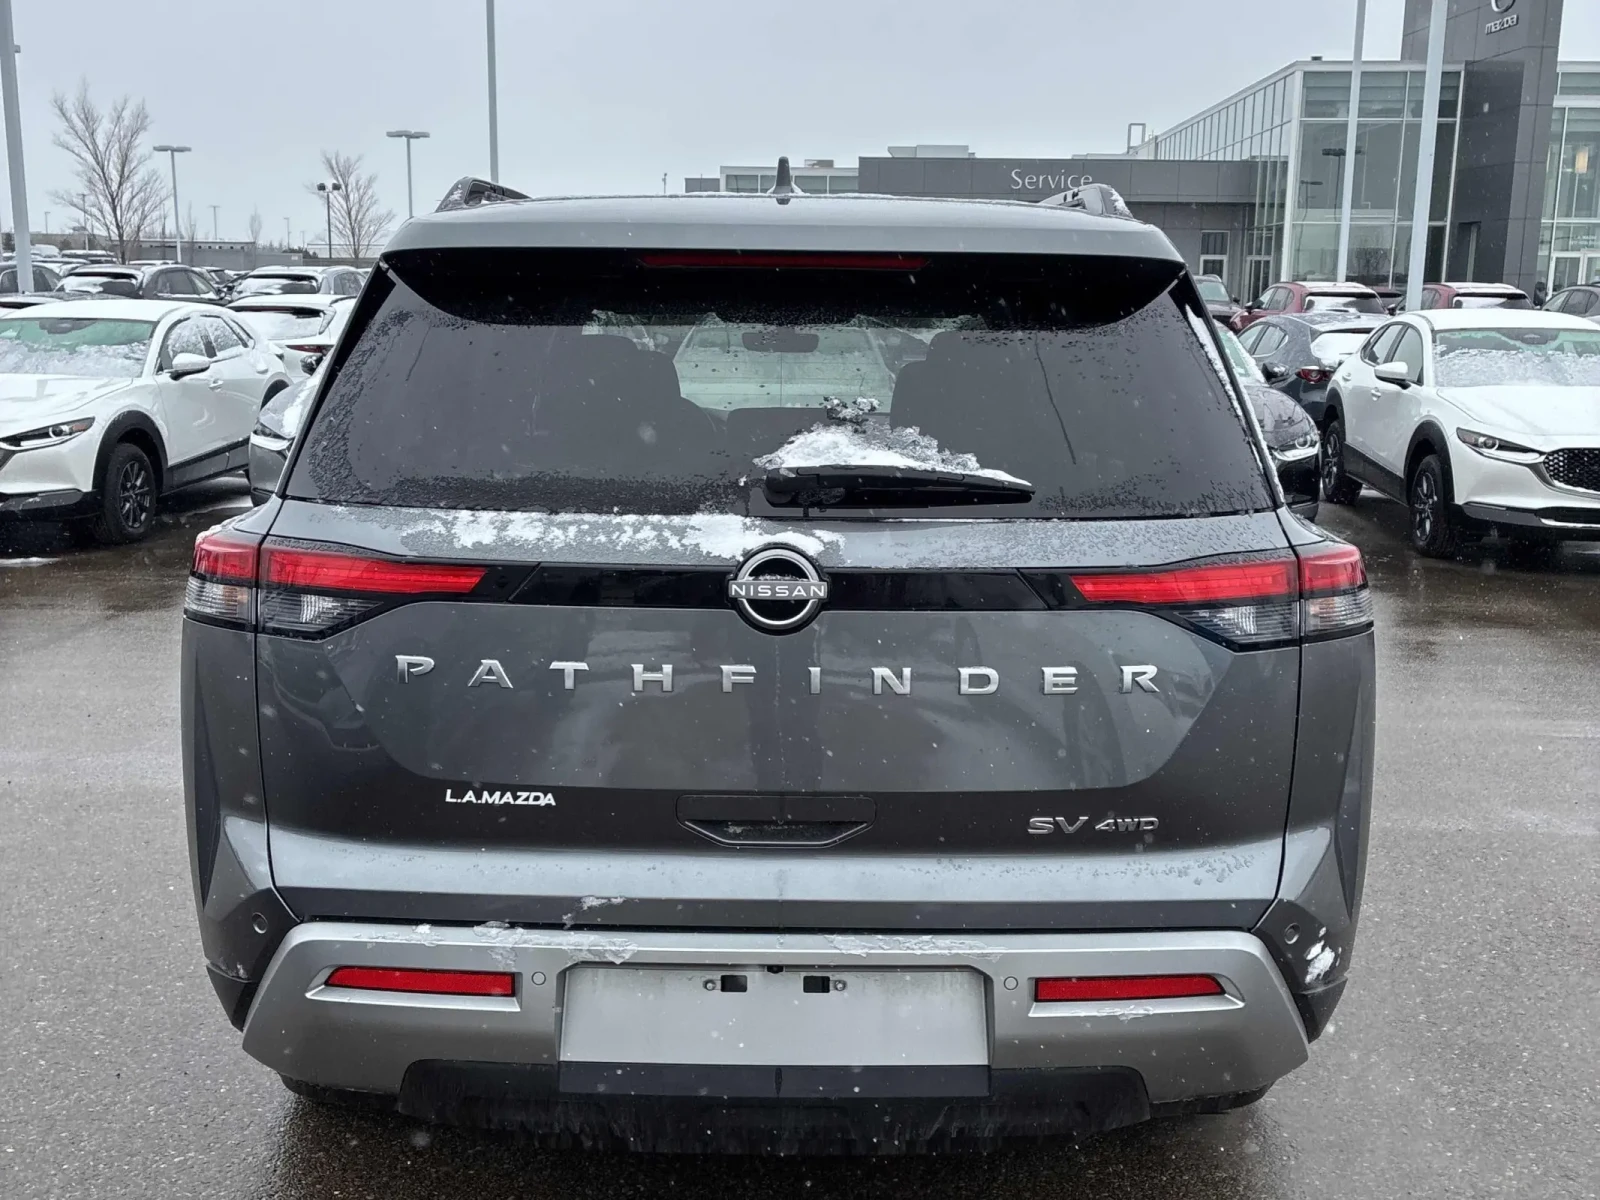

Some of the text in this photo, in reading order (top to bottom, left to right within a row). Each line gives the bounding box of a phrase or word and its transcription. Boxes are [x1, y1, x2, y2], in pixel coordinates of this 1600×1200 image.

[1011, 169, 1093, 189] Service
[731, 584, 824, 597] NISSAN
[395, 654, 1160, 695] PATHFINDER
[1027, 816, 1159, 835] SV 4WD
